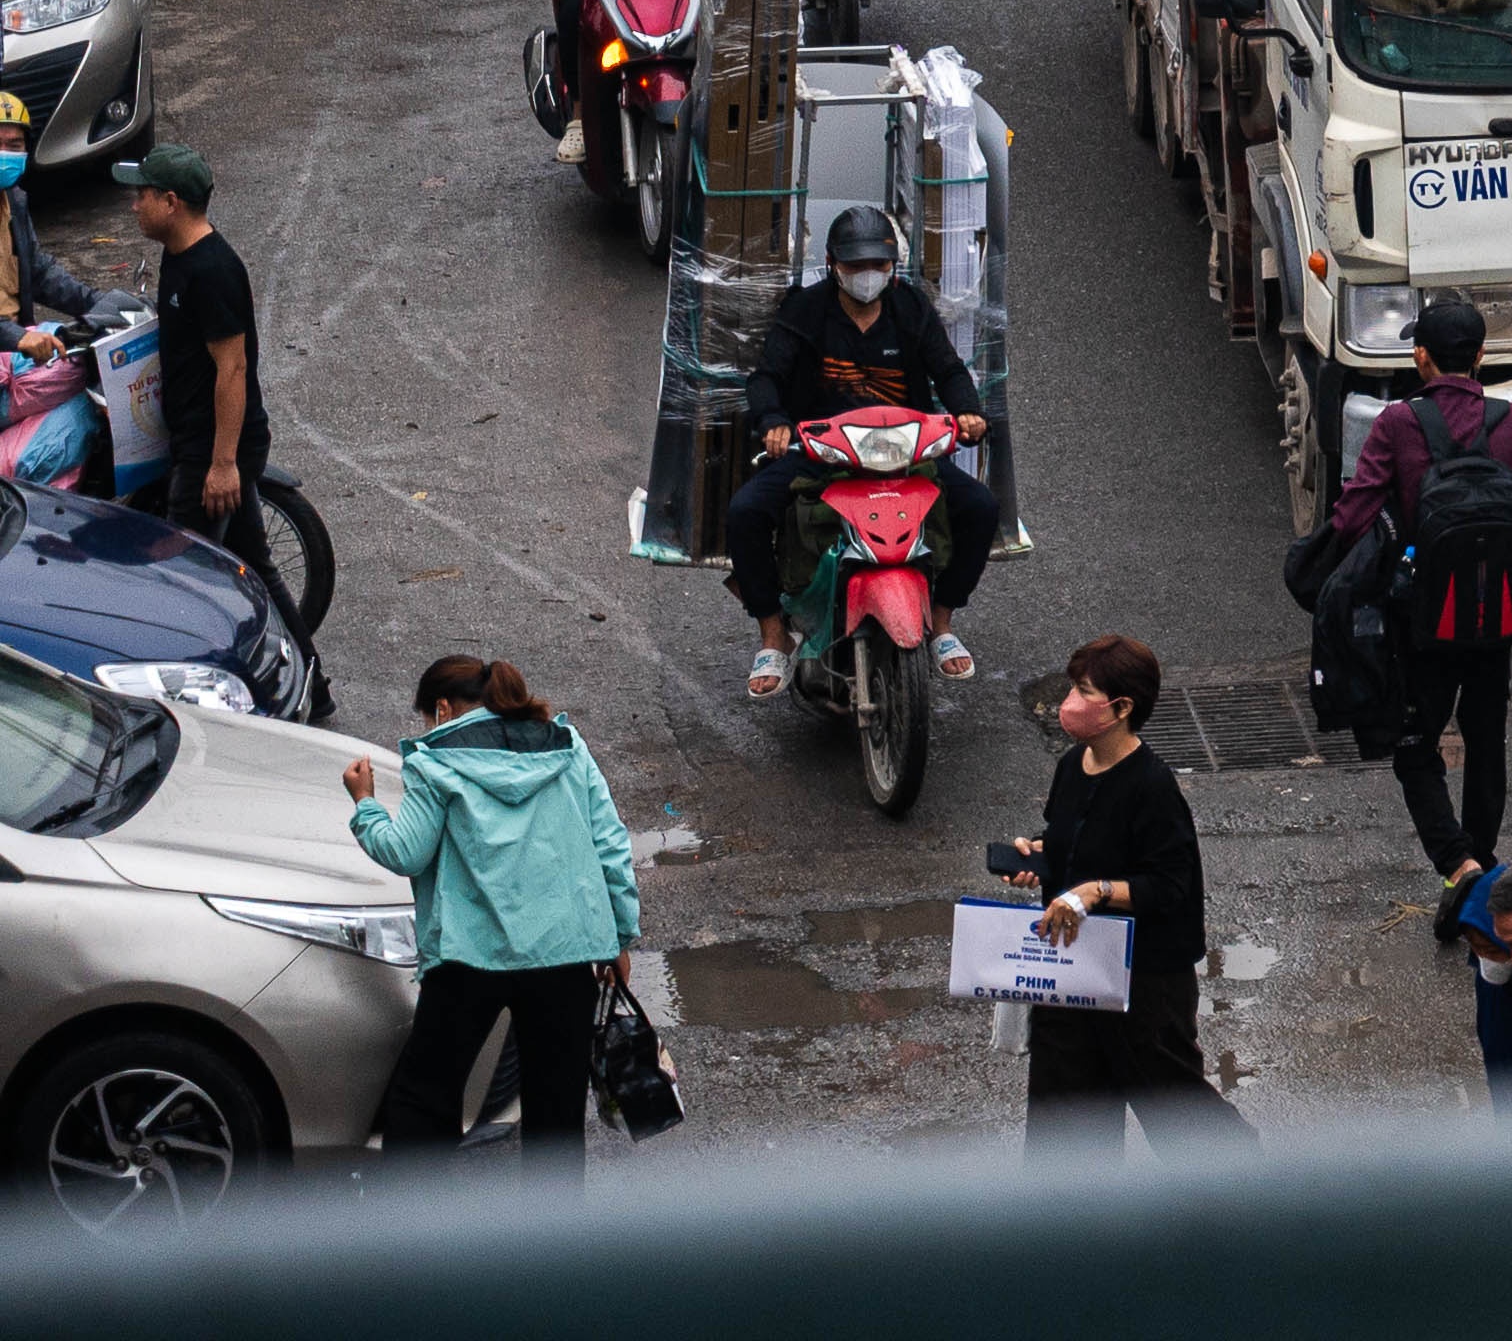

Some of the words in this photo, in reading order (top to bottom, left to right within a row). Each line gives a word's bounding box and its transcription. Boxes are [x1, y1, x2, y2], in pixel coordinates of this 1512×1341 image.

[1015, 975, 1056, 991] PHIM
[974, 987, 1044, 1003] C.T.SCAN
[1049, 993, 1060, 1004] &
[1066, 994, 1097, 1007] MRI
